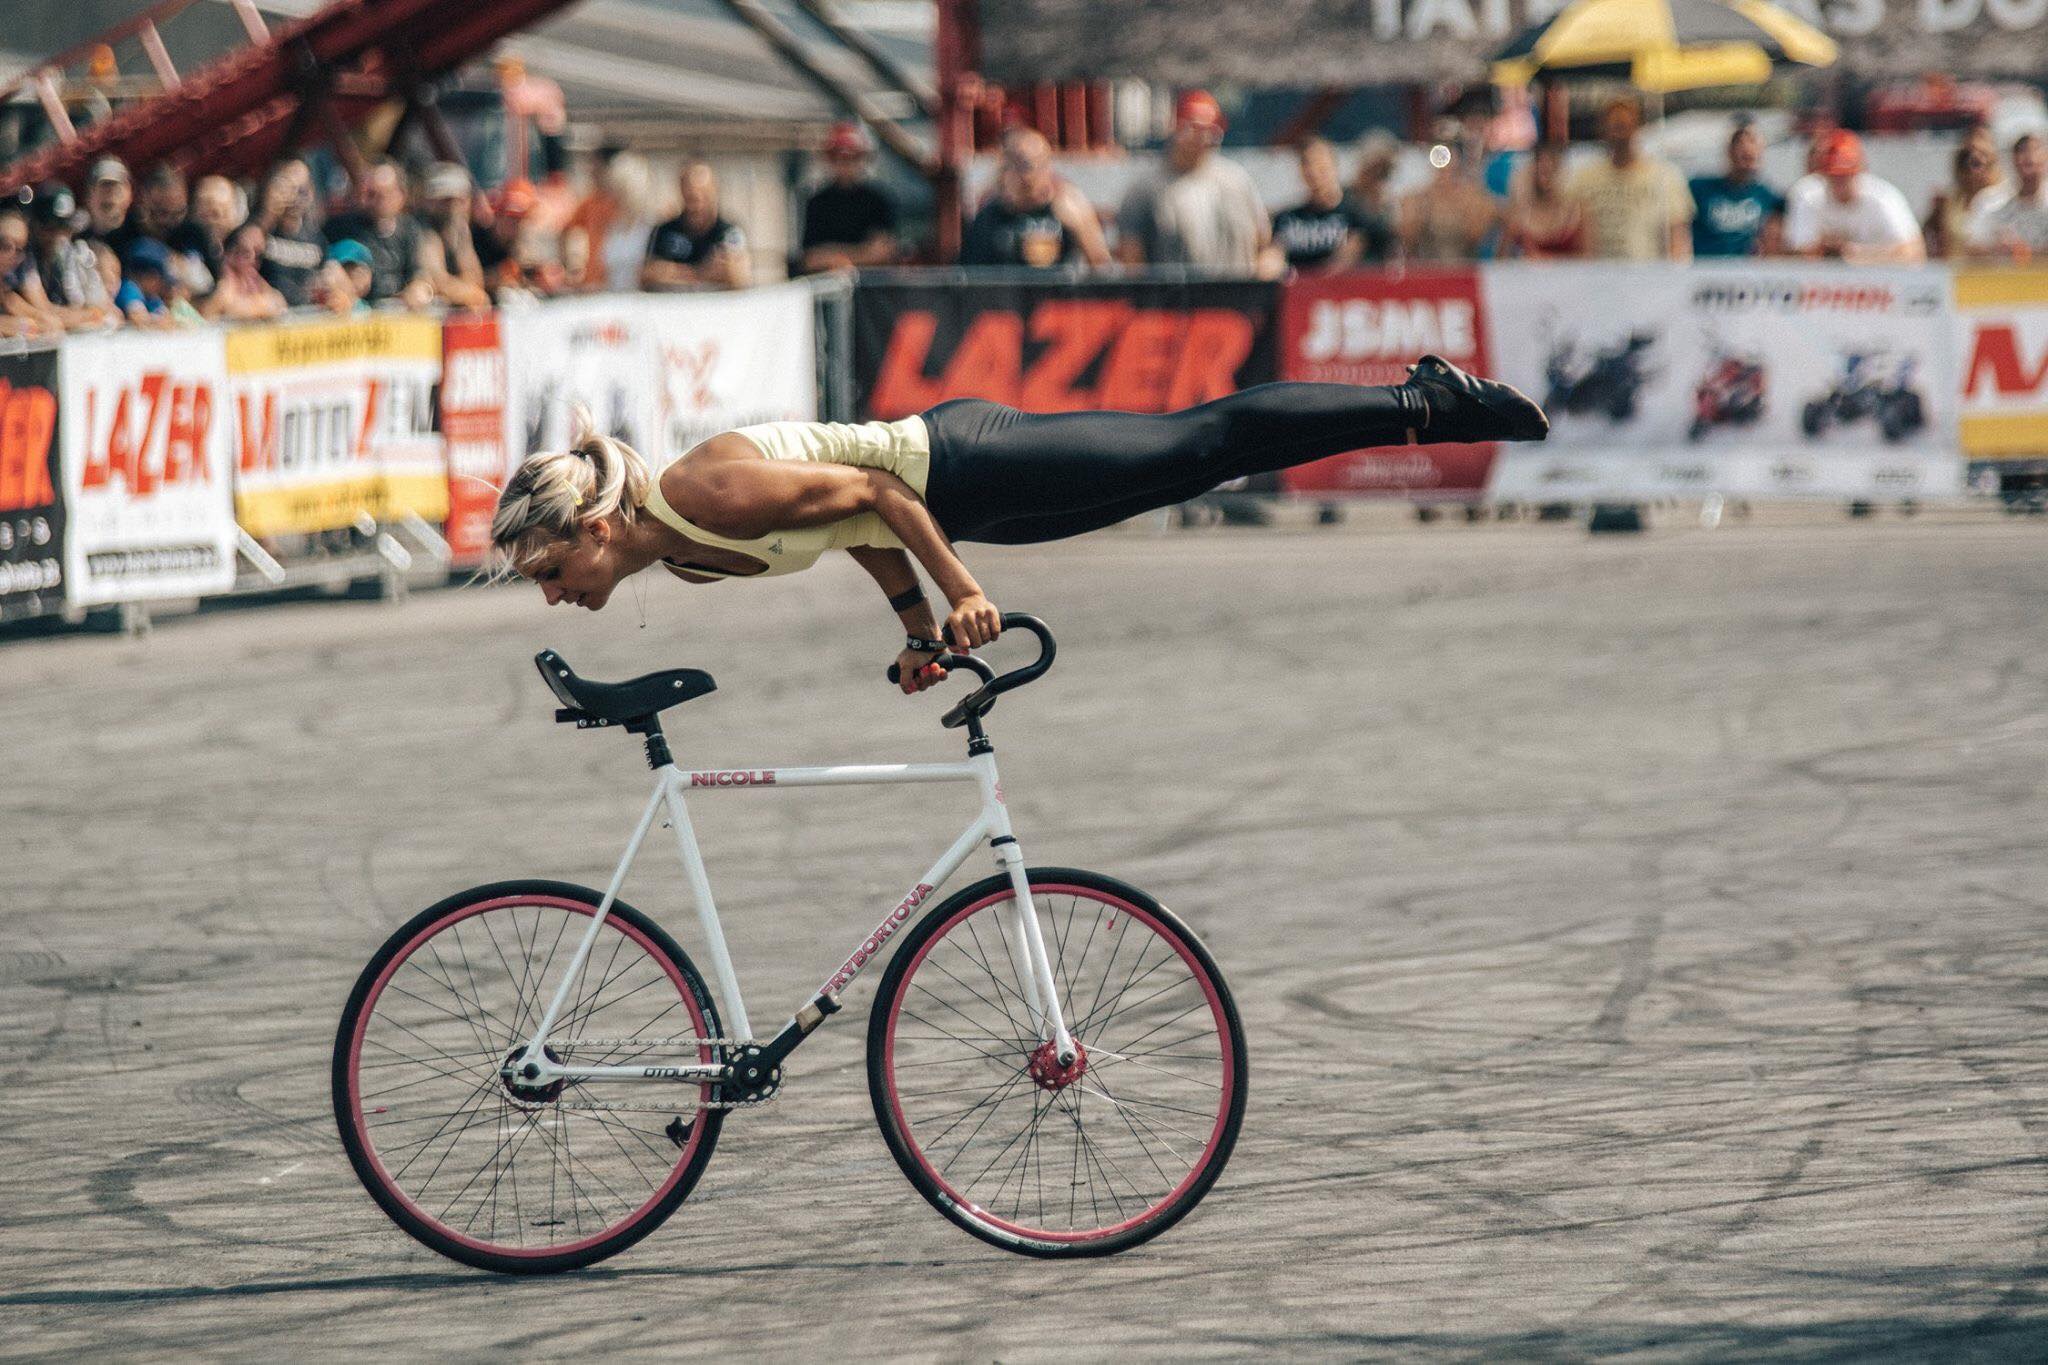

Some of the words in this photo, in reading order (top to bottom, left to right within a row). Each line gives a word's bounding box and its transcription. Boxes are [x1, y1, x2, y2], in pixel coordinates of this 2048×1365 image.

[872, 298, 1255, 416] LAZER
[1303, 298, 1477, 361] JSME
[82, 372, 214, 496] LAZER
[691, 770, 776, 786] NICOLE
